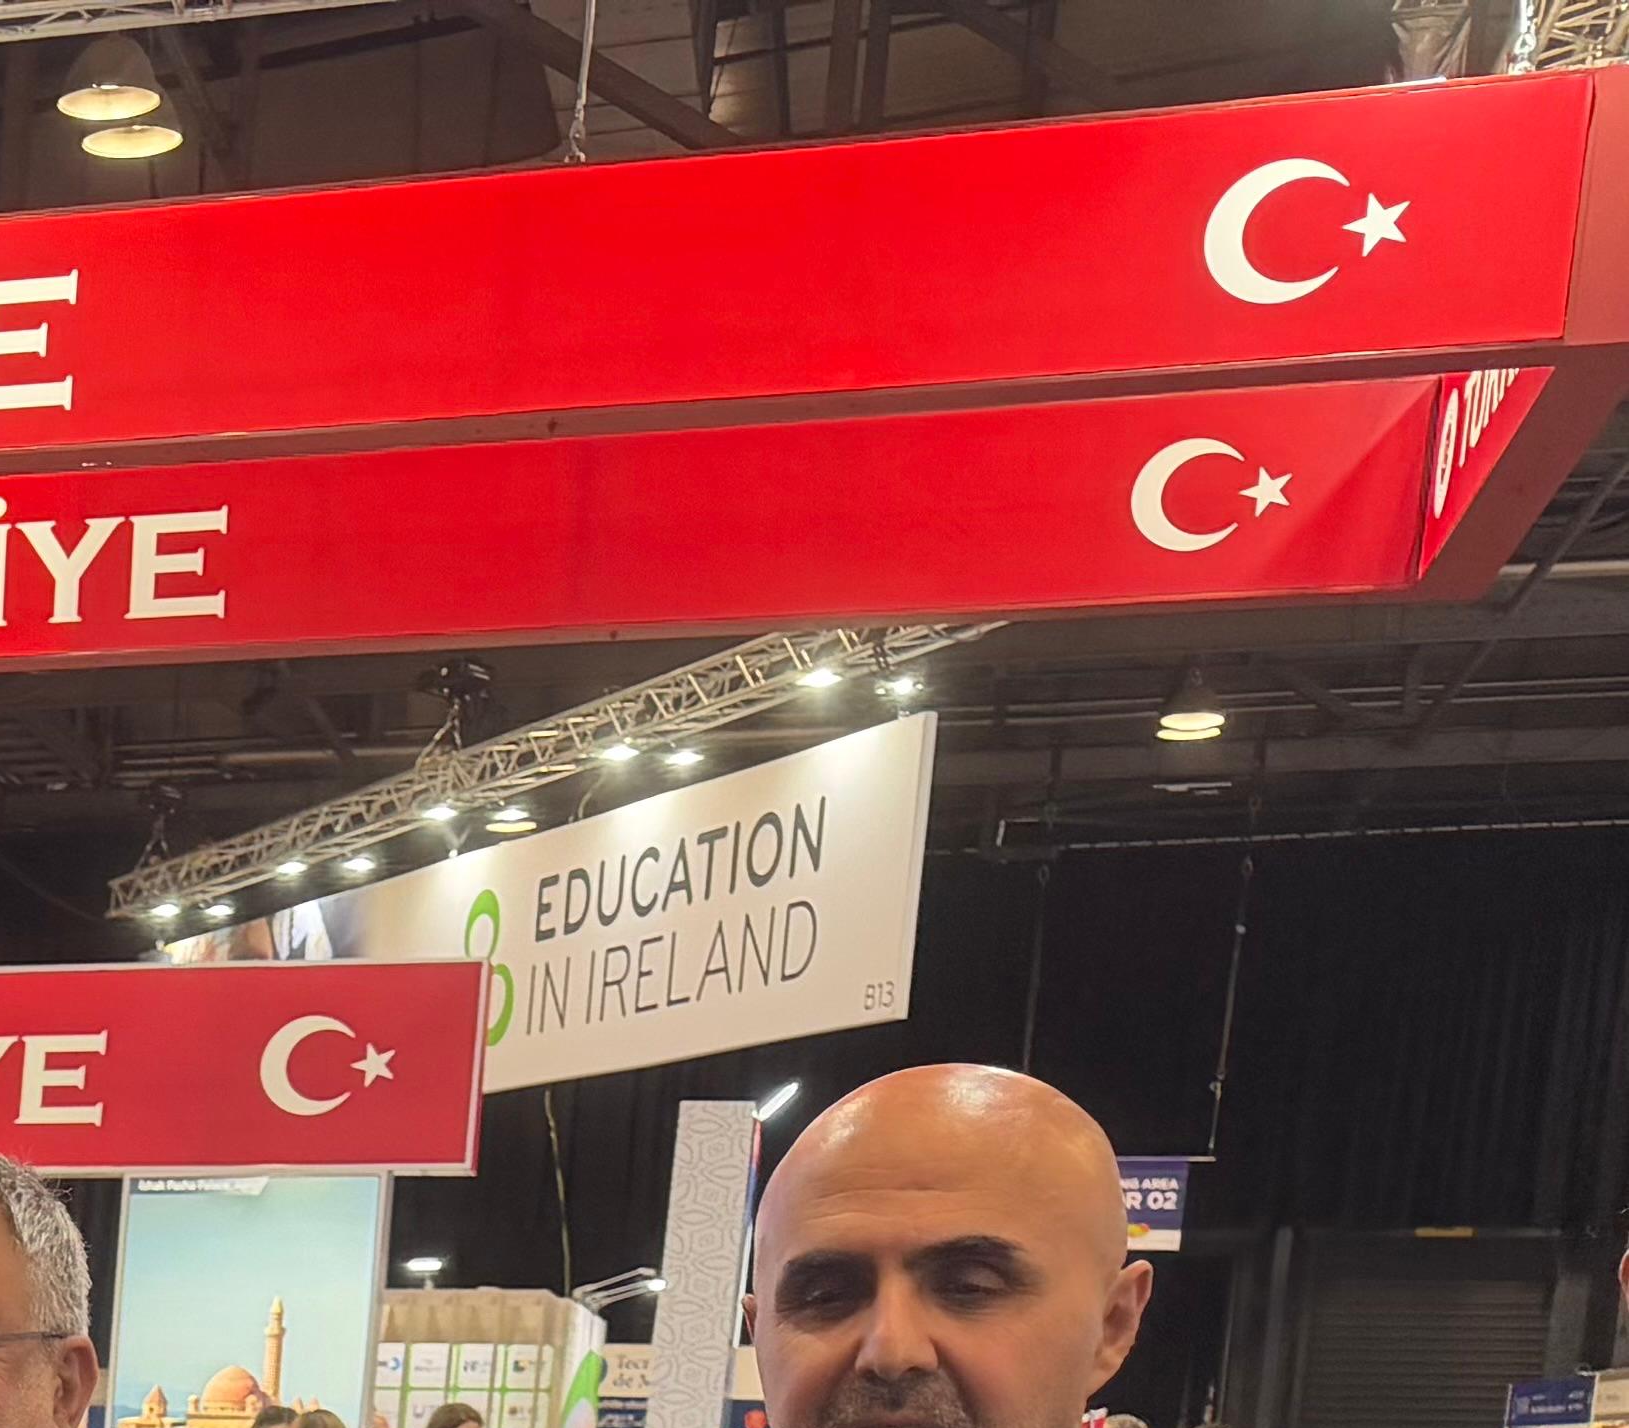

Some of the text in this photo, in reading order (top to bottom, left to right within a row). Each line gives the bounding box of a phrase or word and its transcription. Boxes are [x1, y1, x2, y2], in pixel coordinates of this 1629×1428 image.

[534, 795, 826, 943] EDUCATION
[526, 901, 816, 1036] IN IRELAND
[1125, 1192, 1142, 1209] R
